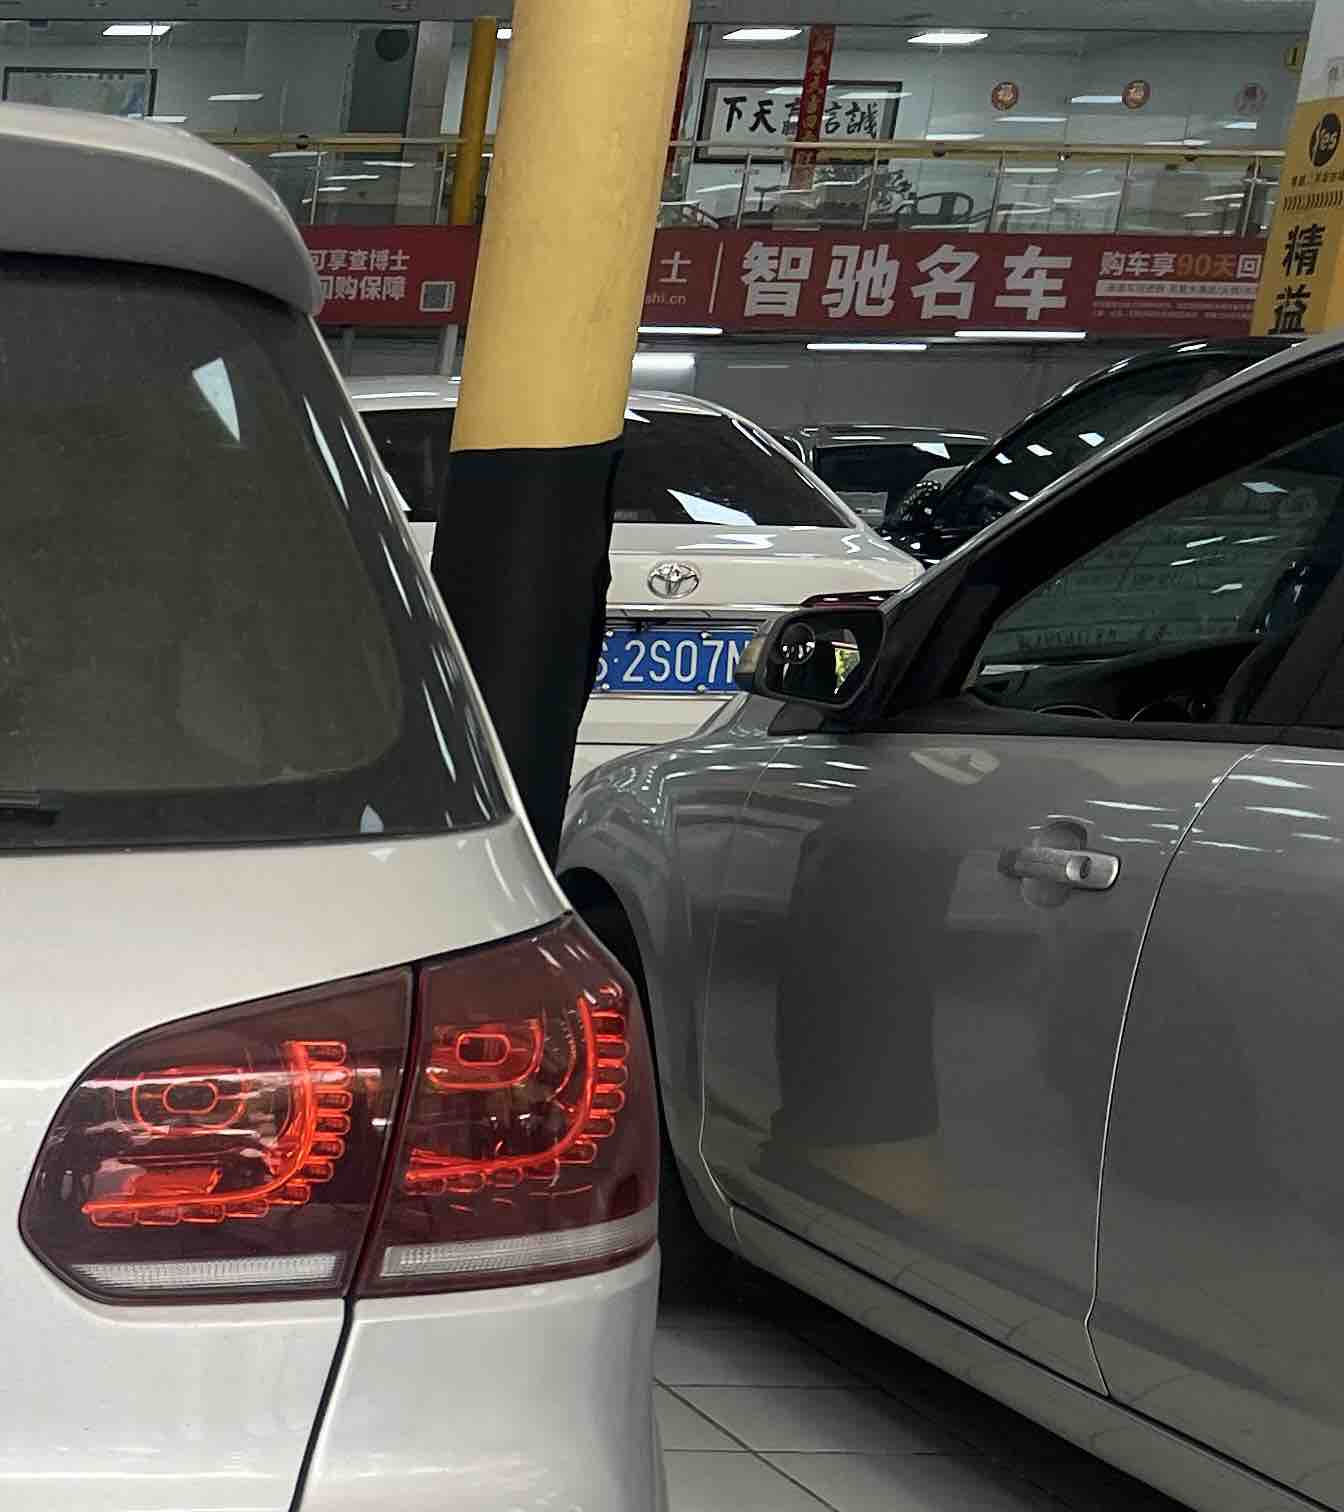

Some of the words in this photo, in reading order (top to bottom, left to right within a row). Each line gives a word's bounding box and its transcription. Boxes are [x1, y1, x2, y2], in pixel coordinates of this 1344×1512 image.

[659, 251, 691, 283] 士
[741, 241, 1073, 320] 智驰名车
